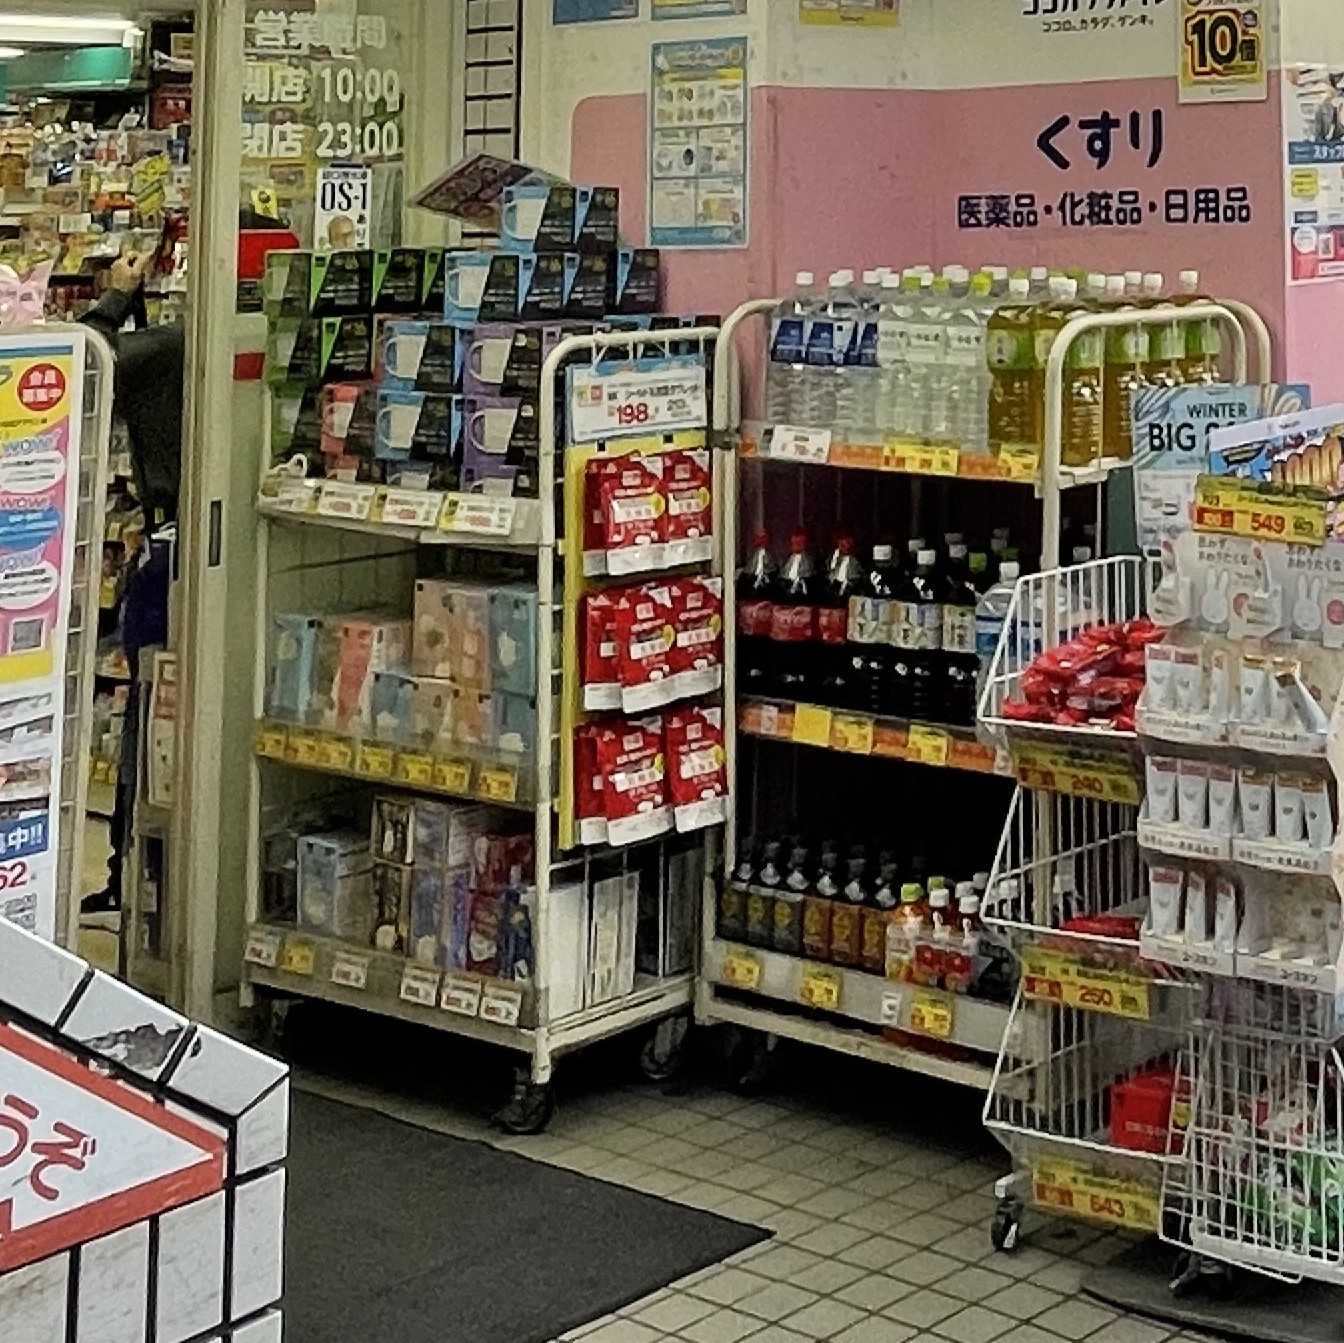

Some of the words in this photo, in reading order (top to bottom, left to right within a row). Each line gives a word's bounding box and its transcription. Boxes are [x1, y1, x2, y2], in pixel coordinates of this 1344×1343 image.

[320, 65, 400, 103] 10:00
[315, 121, 399, 158] 23:00
[1036, 108, 1164, 171] くすり
[957, 186, 1252, 229] 医薬品・化粧品・日用品
[617, 403, 649, 425] 198
[1186, 402, 1249, 419] WINTER
[1148, 422, 1197, 452] BIG
